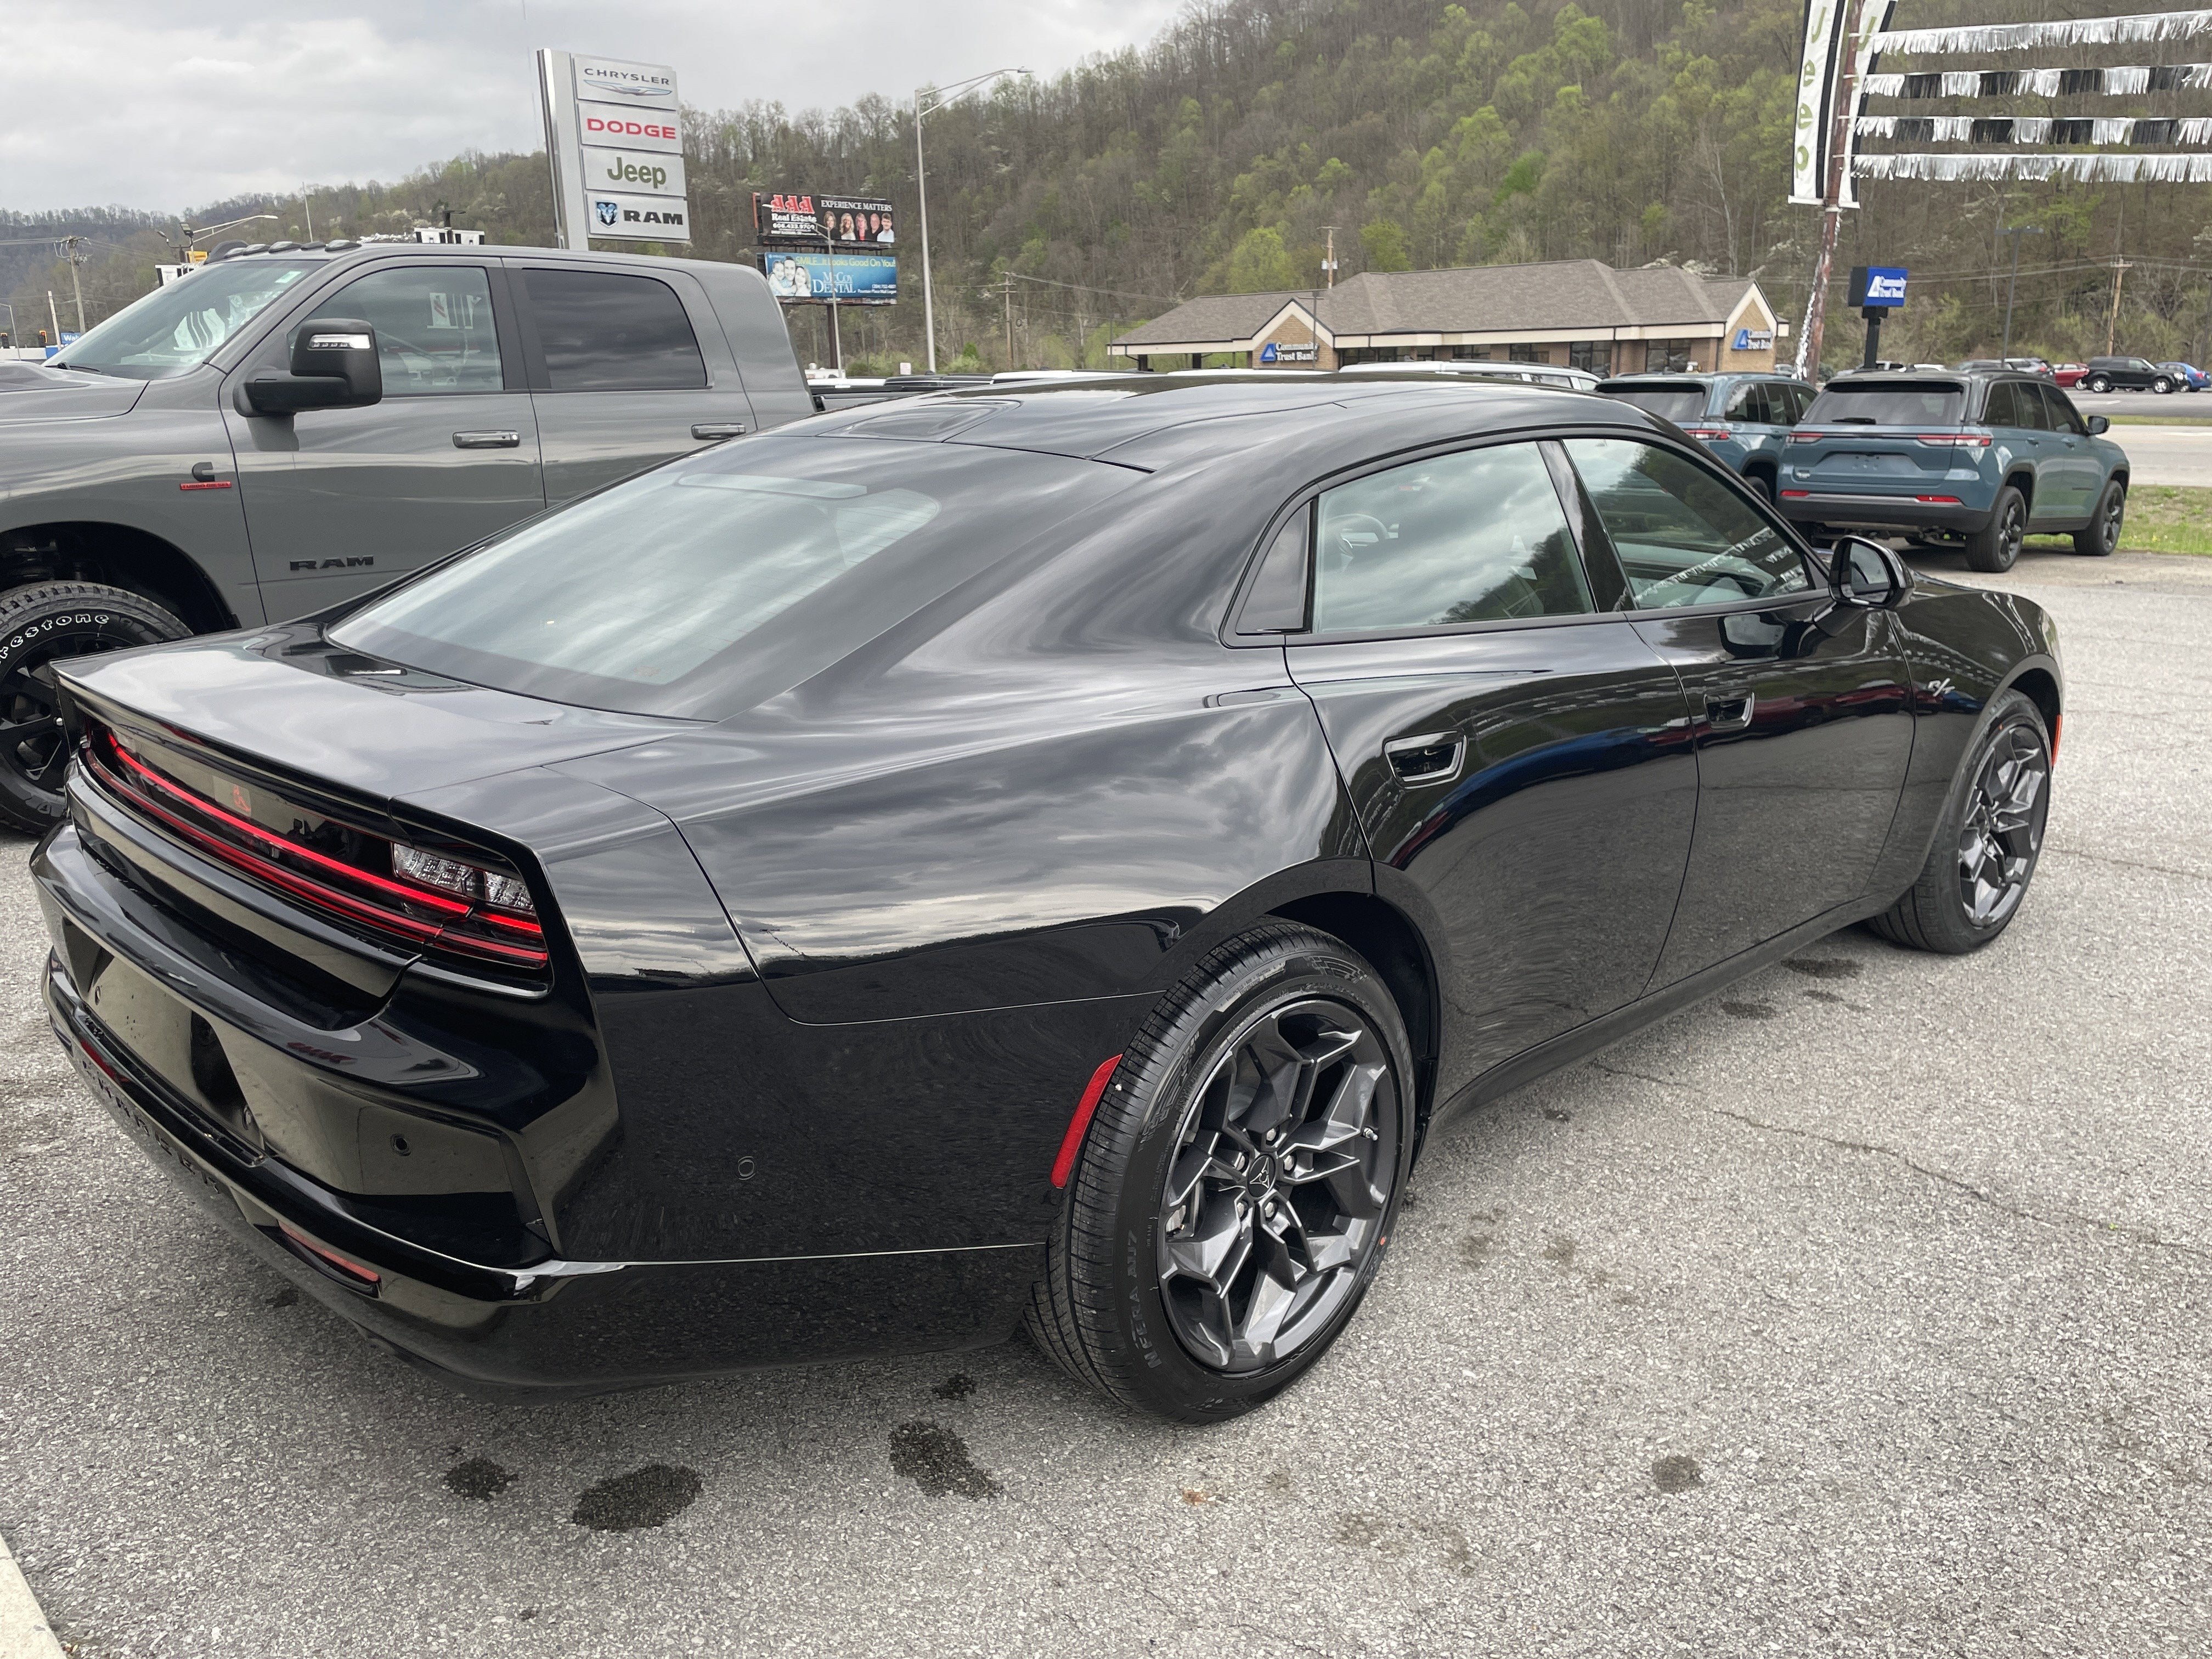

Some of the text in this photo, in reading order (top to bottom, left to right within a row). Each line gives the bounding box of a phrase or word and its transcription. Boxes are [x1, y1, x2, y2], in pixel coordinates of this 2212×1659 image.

[584, 67, 670, 86] CHRYSLER
[587, 118, 676, 139] DODGE
[607, 157, 666, 188] Jeep
[821, 200, 893, 212] EXPERIENCE MATTERS
[623, 210, 684, 225] RAM
[849, 258, 869, 267] Good
[870, 258, 881, 267] On
[290, 550, 374, 571] RAM
[0, 613, 110, 659] restone
